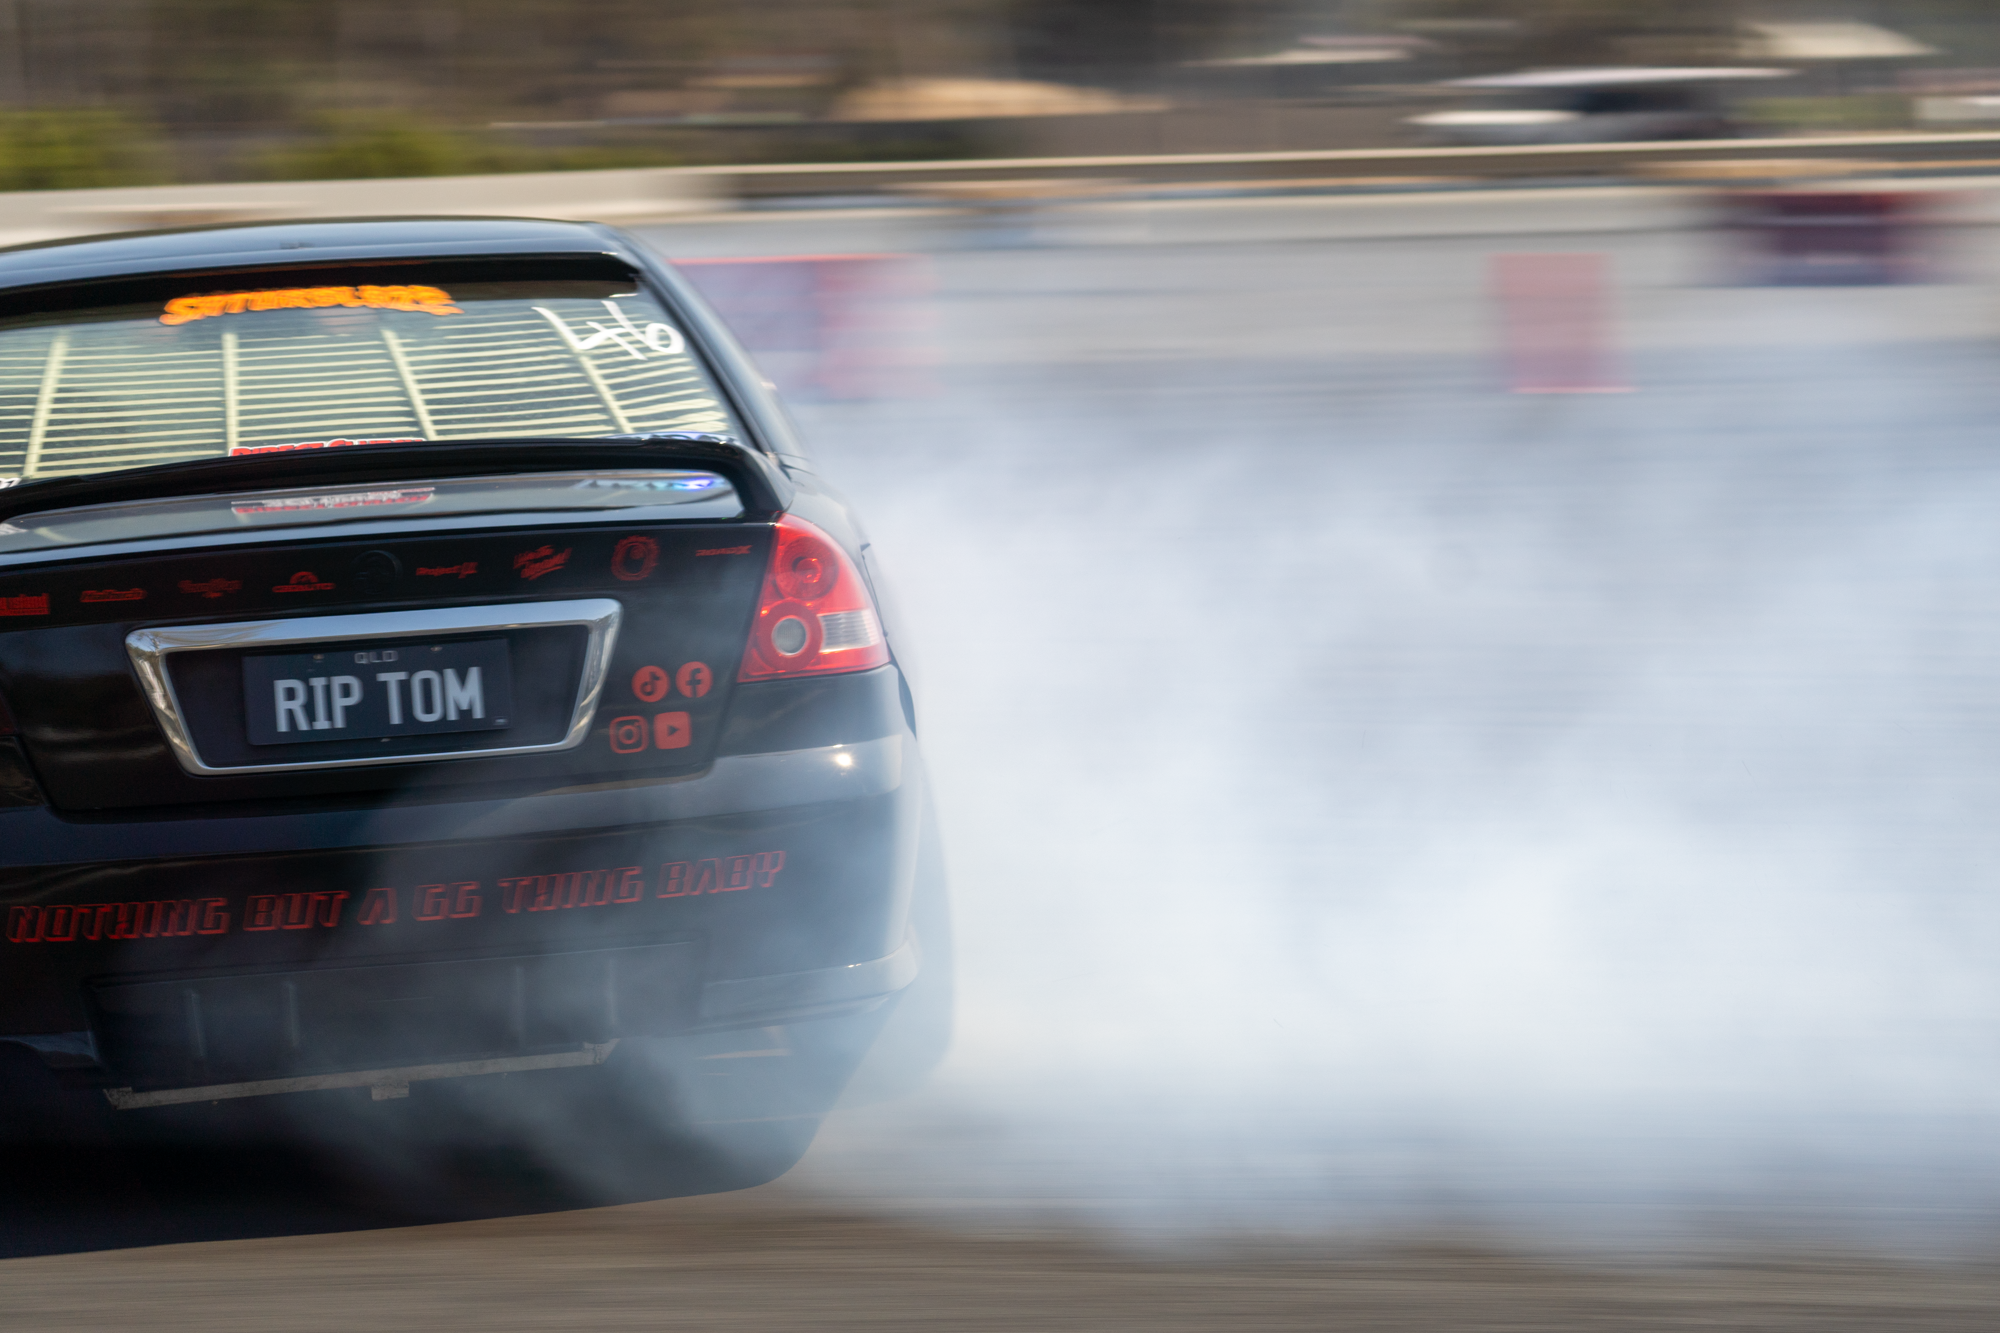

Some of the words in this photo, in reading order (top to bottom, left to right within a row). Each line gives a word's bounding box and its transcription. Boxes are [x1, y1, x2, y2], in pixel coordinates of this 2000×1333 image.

[354, 650, 399, 664] QLD
[273, 675, 364, 732] RIP
[376, 666, 485, 724] TOM
[5, 897, 232, 943] NOTHING
[243, 890, 349, 931] BUT
[357, 887, 399, 926] A
[497, 866, 645, 914] THING
[655, 850, 787, 899] BABY
